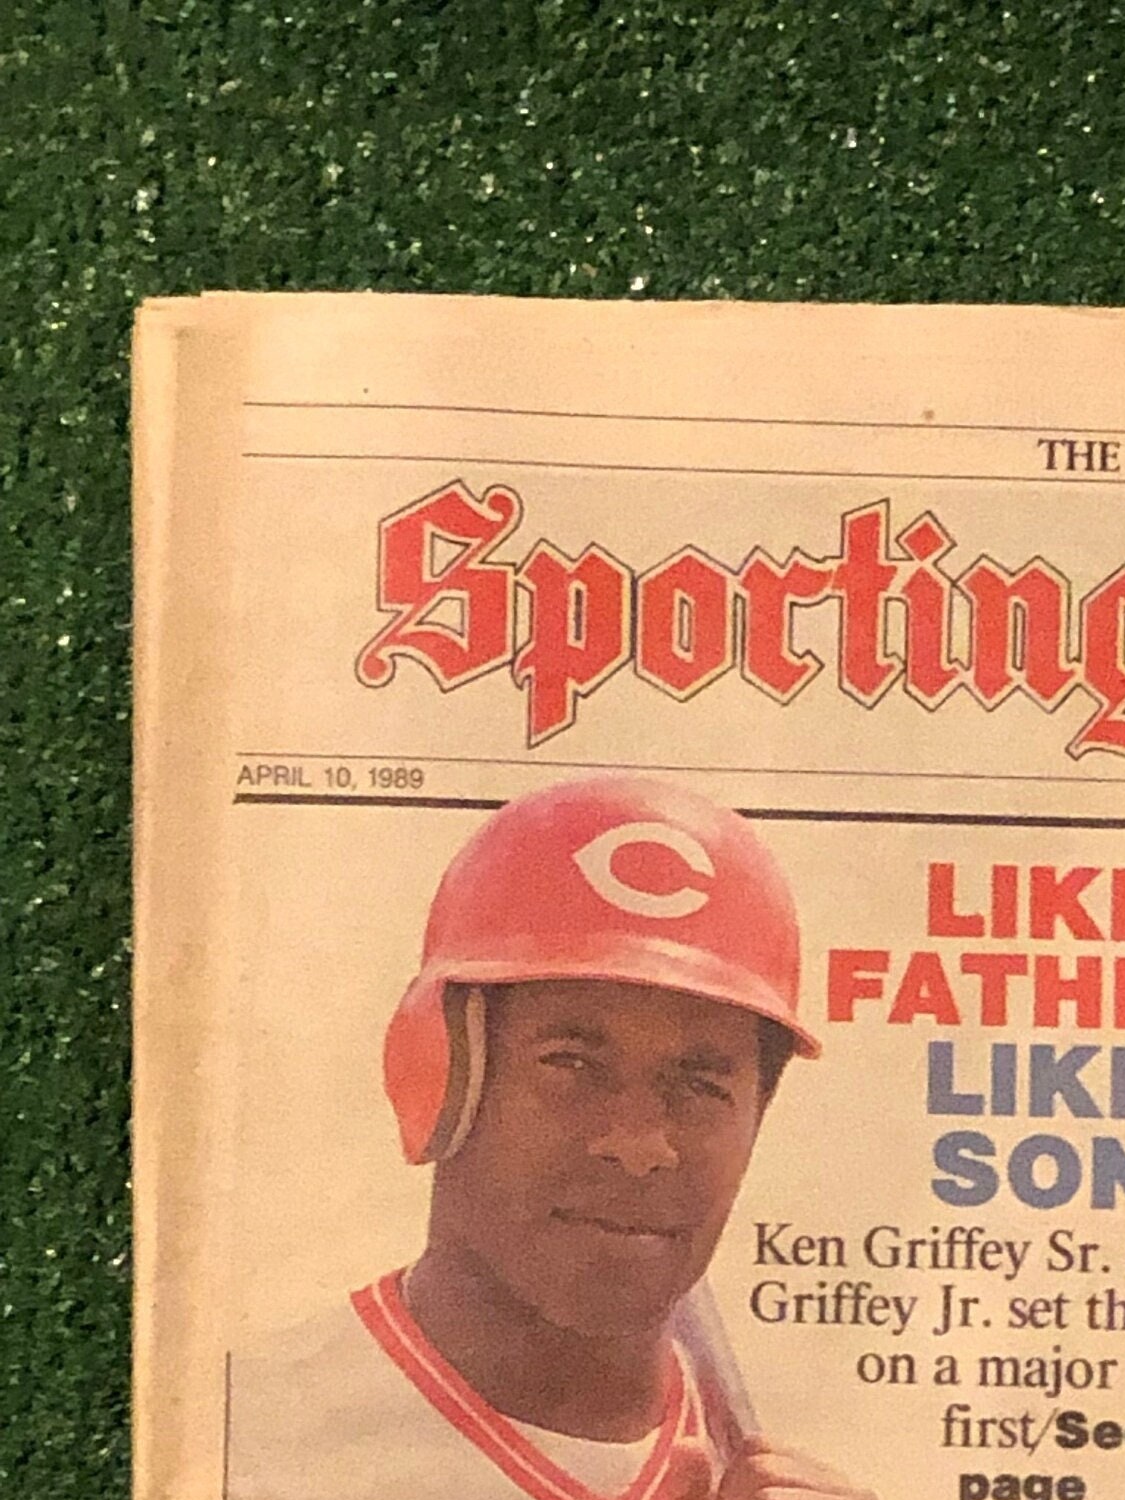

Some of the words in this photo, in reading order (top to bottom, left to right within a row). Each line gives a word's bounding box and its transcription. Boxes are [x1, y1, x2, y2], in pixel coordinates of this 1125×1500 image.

[1037, 439, 1121, 473] THE
[236, 764, 312, 788] APRIL
[324, 766, 359, 793] 10,
[367, 768, 424, 790] 1989
[571, 821, 715, 919] C
[753, 1223, 847, 1267] Ken
[864, 1226, 1031, 1281] Griffey
[1047, 1229, 1110, 1273] Sr.
[750, 1281, 917, 1336] Griffey
[932, 1285, 992, 1335] Jr.
[1008, 1289, 1071, 1330] set
[856, 1351, 918, 1386] on
[934, 1356, 960, 1387] a
[978, 1345, 1118, 1398] major
